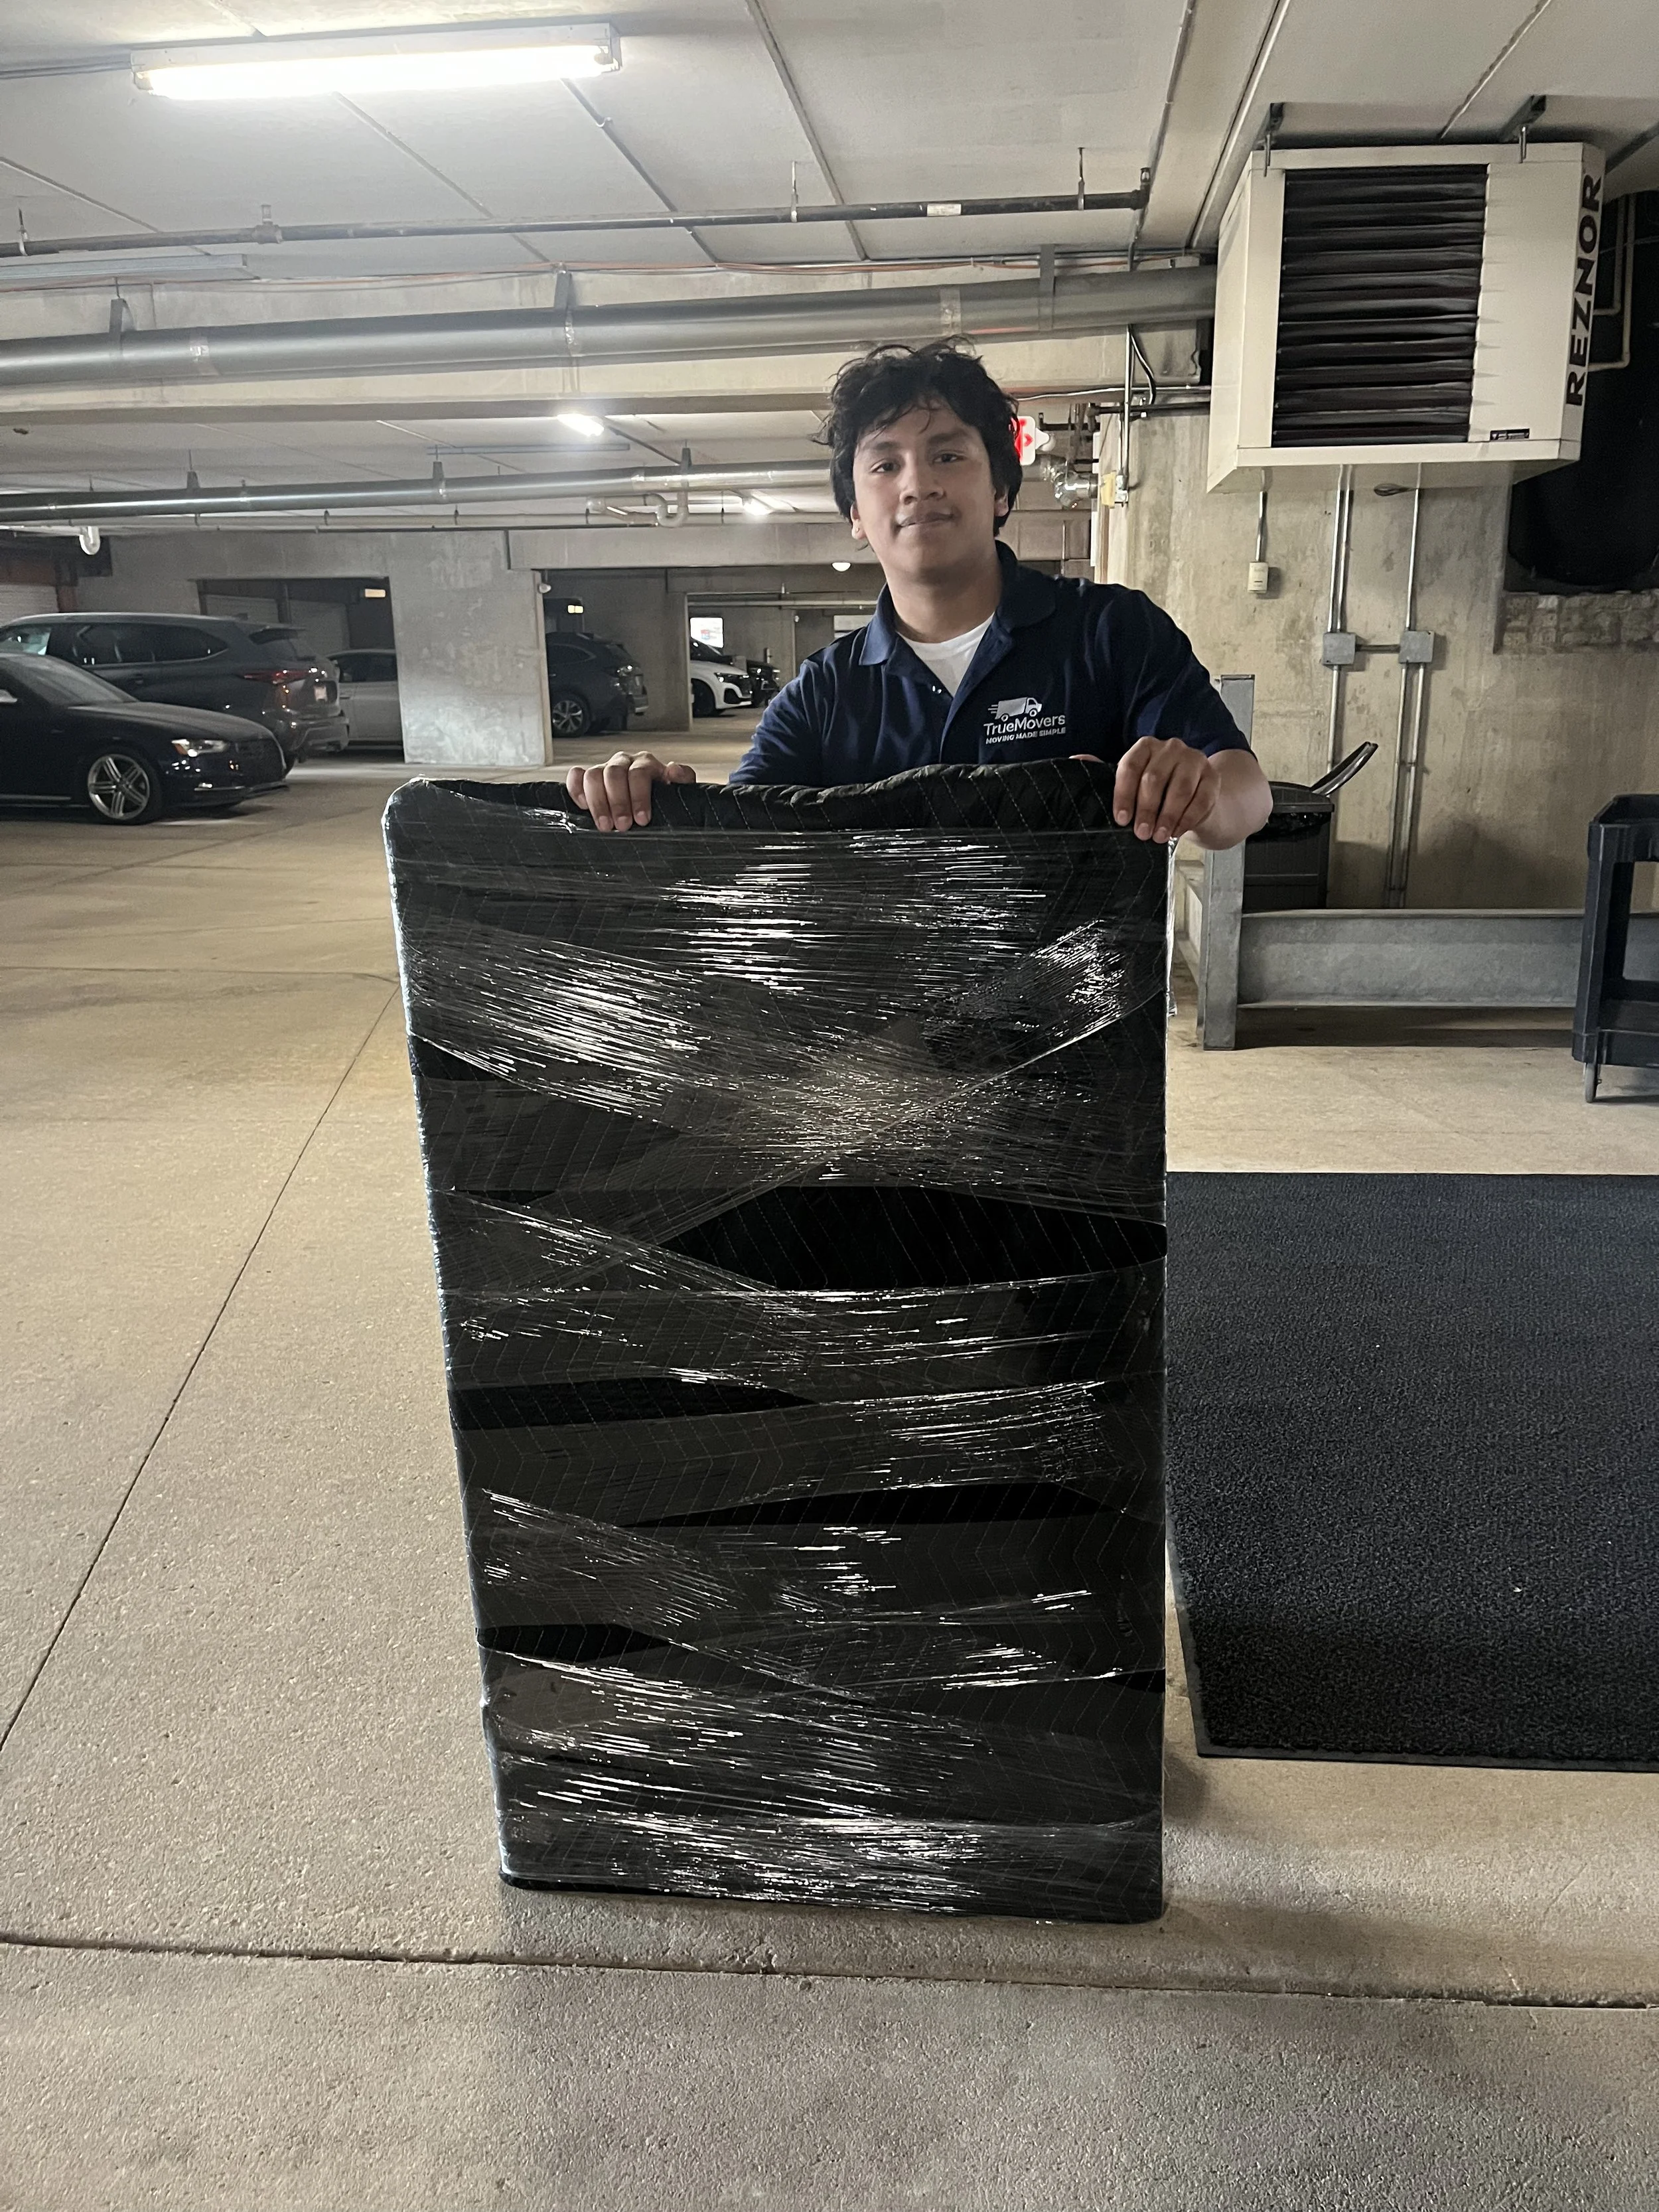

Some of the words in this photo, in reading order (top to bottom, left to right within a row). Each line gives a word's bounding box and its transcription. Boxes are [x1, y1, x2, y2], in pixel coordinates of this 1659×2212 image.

[1566, 175, 1601, 406] REZNOR
[983, 715, 1066, 736] TrueMovers
[985, 734, 1015, 745] MOVING
[1015, 731, 1038, 739] MADE
[1039, 727, 1066, 737] SIMPLE
